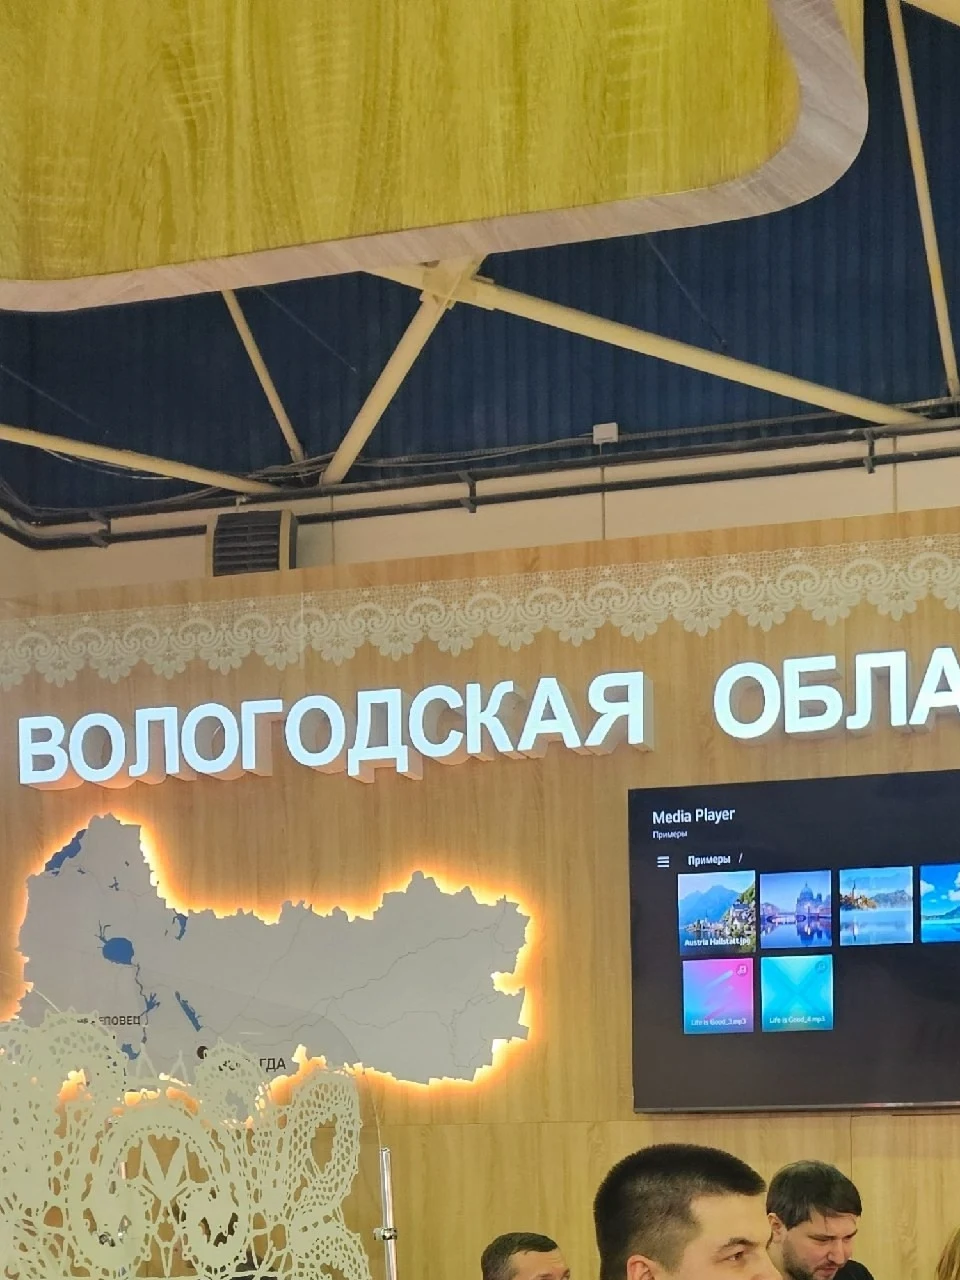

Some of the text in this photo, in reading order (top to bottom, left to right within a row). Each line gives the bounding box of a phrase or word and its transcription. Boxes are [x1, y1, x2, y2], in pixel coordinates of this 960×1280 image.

[19, 671, 646, 785] ВОЛОГОДСКАЯ
[652, 808, 736, 825] Media Player
[652, 830, 688, 840] Примеры
[688, 855, 731, 867] Примеры
[684, 938, 709, 947] Austria
